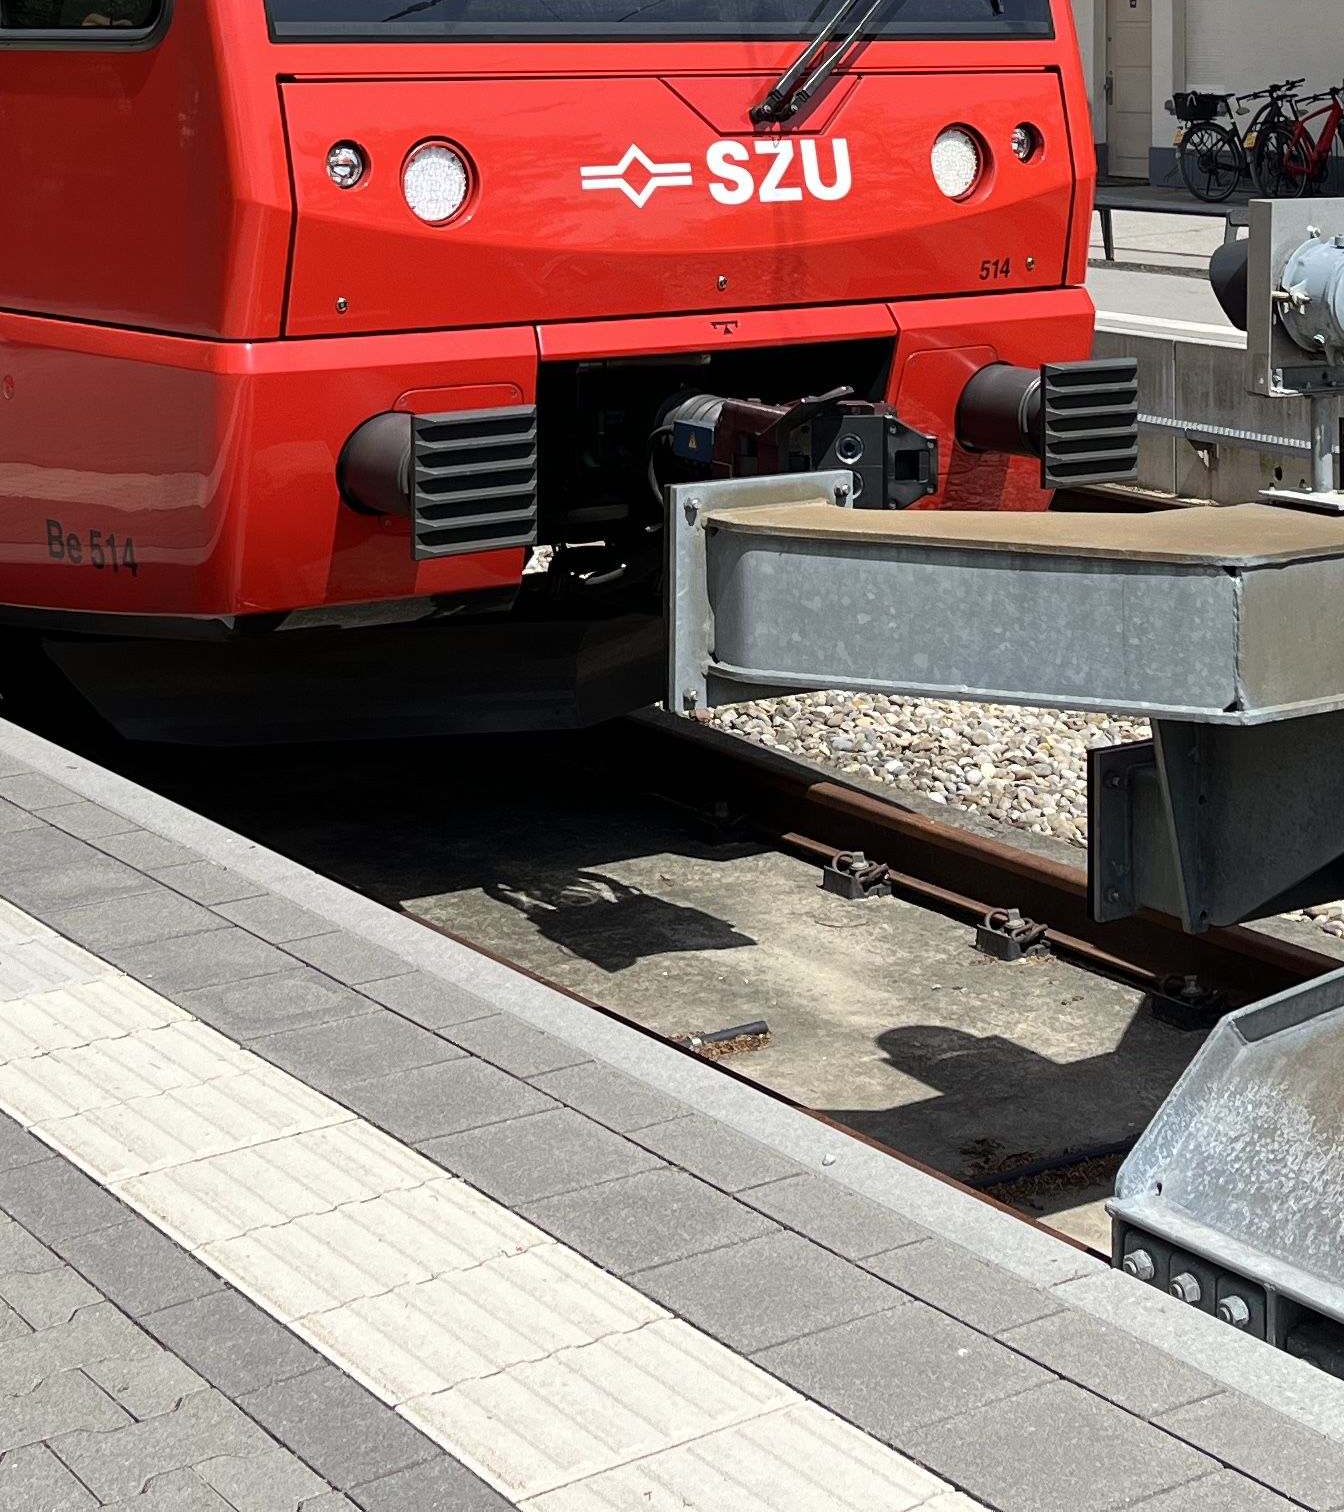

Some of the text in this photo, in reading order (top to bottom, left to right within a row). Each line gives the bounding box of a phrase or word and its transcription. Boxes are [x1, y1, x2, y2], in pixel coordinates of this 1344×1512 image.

[706, 137, 852, 205] SZU
[979, 257, 1011, 281] 514
[45, 518, 139, 578] Be 514
